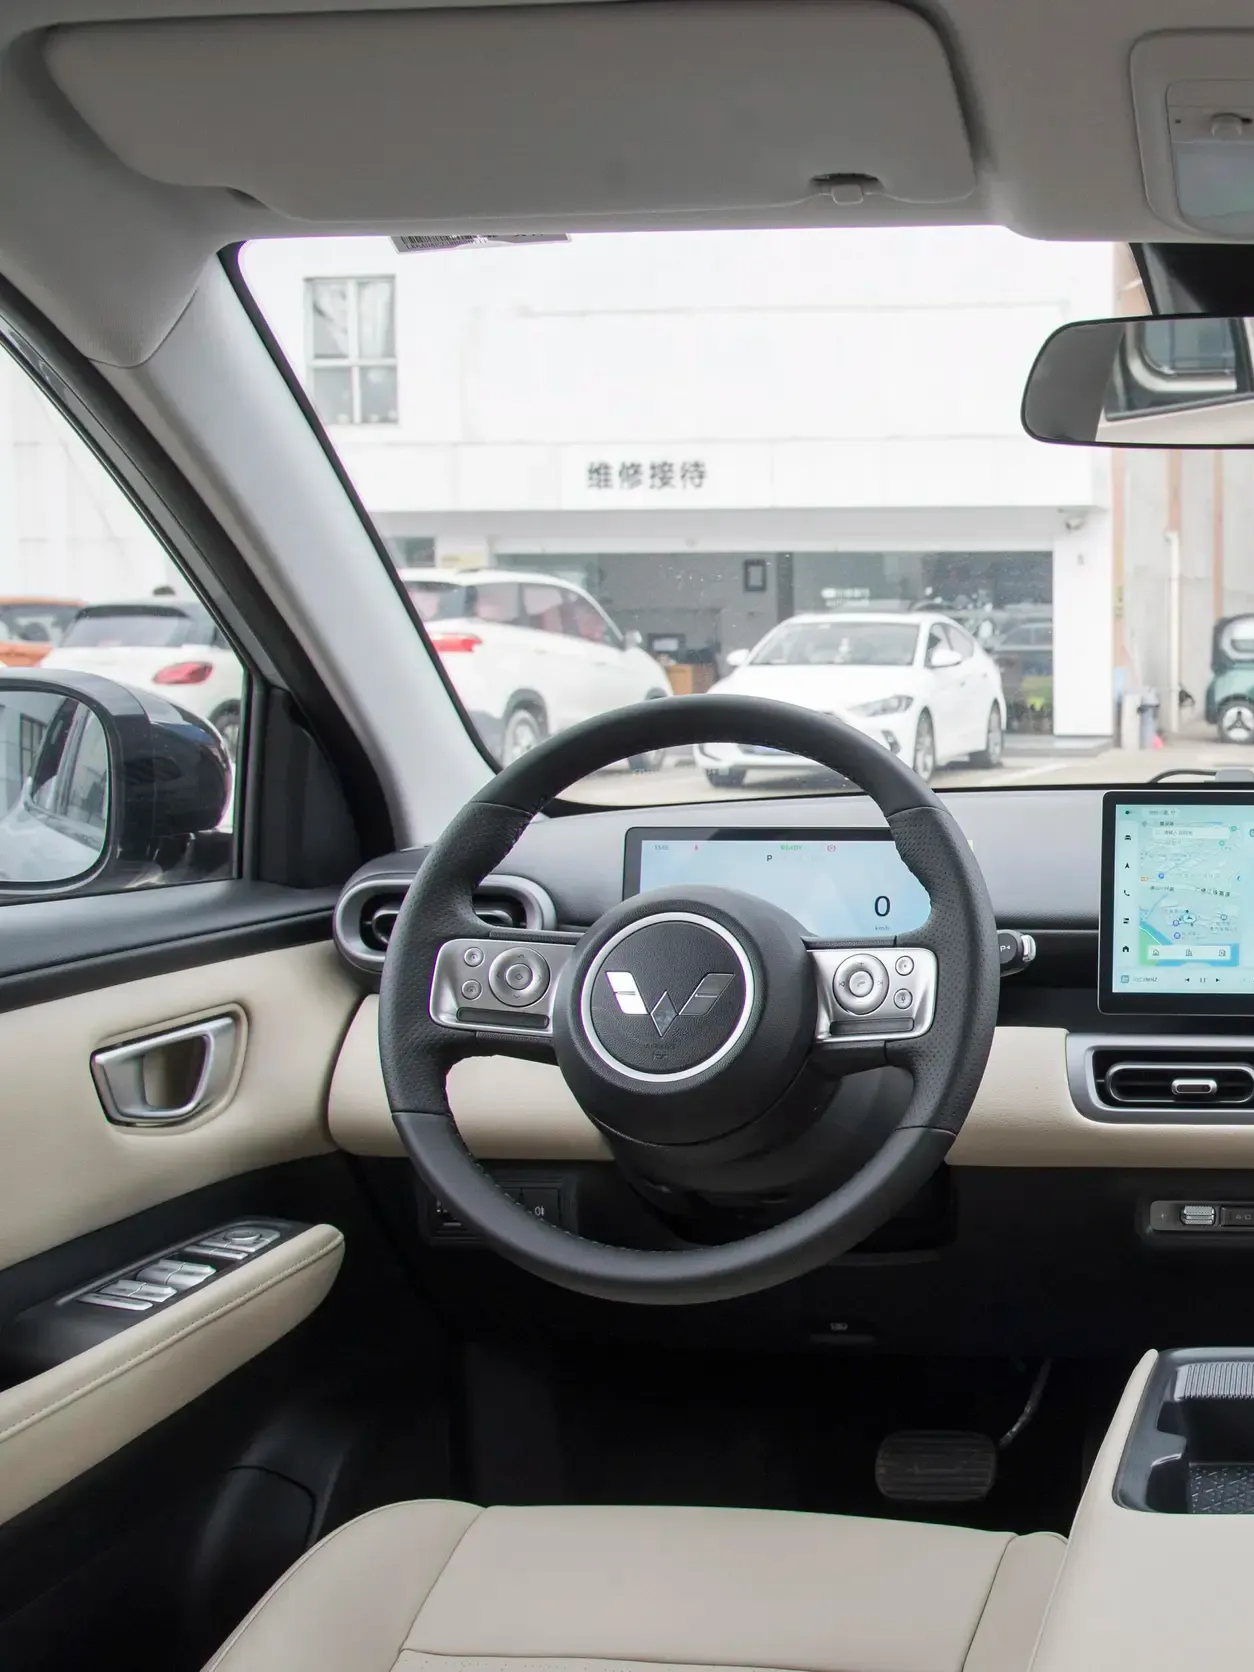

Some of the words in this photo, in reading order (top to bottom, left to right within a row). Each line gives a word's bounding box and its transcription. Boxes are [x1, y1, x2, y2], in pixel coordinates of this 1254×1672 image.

[587, 461, 706, 490] 维修接待
[766, 854, 773, 862] P
[874, 895, 891, 917] 0
